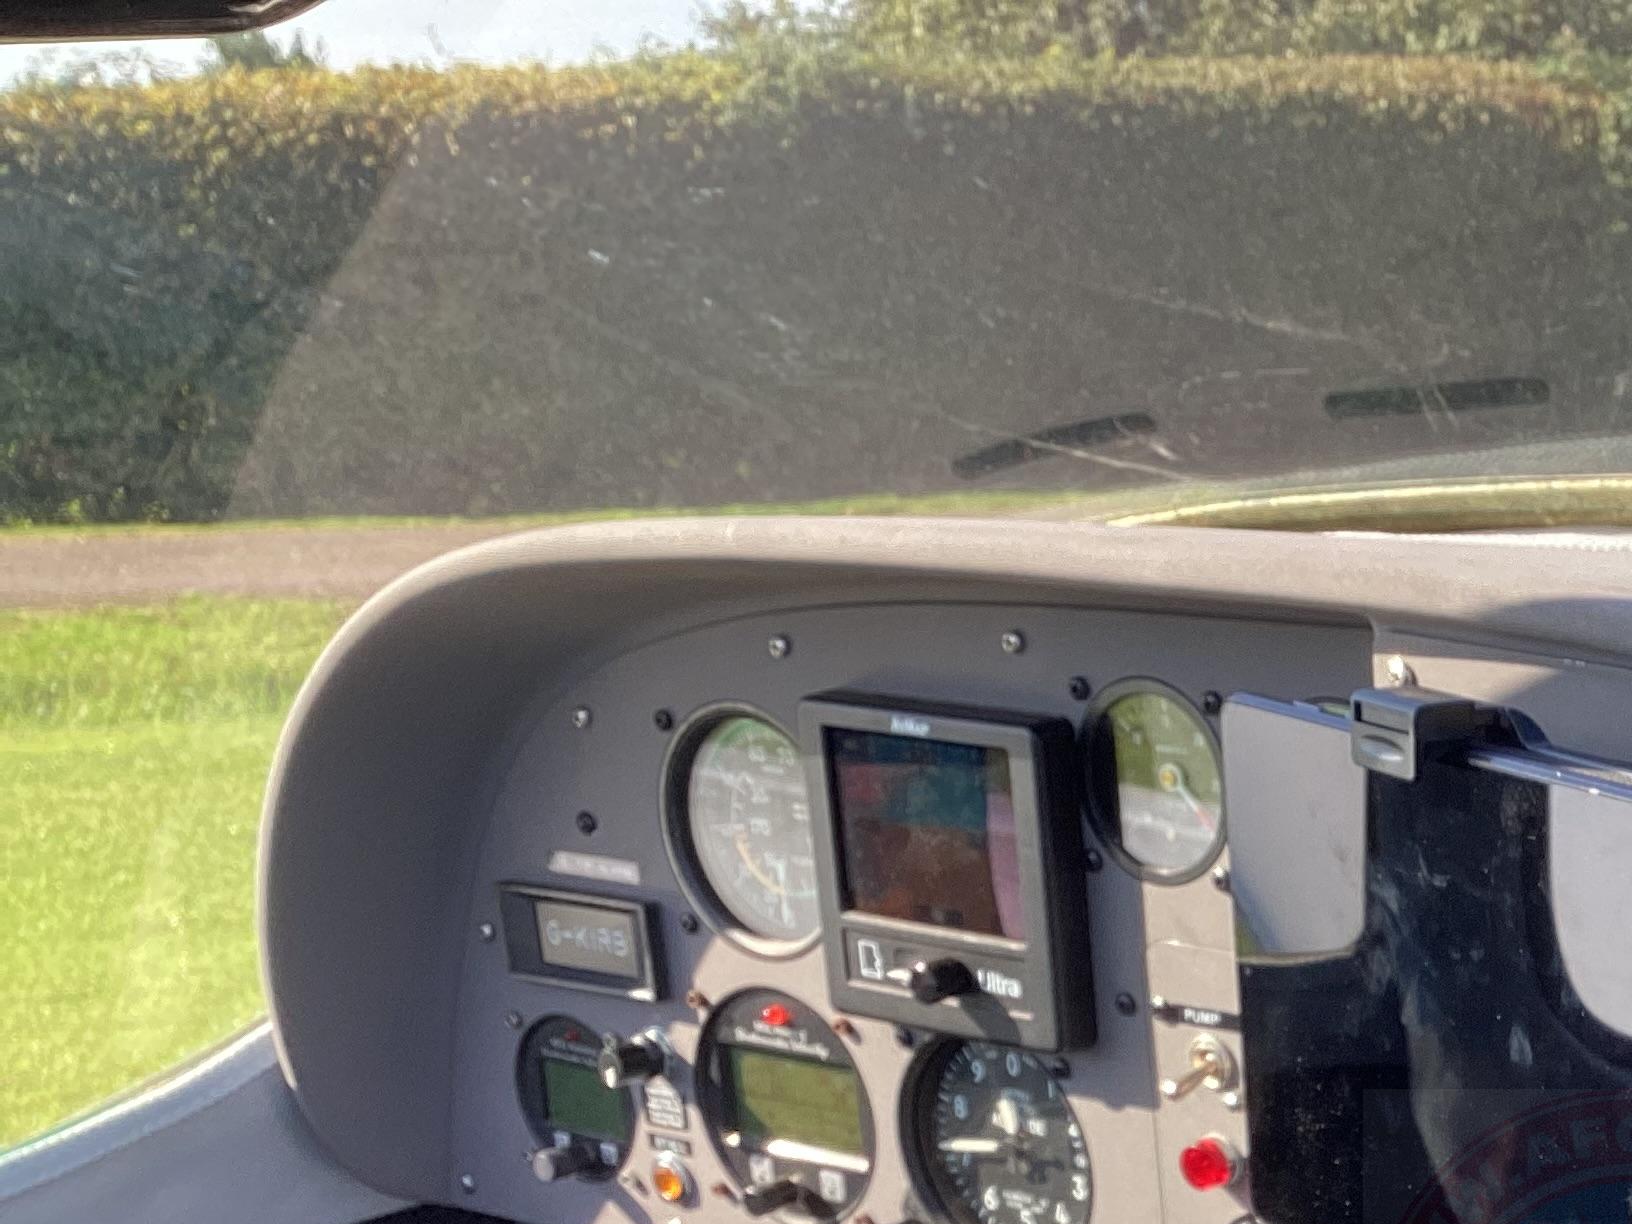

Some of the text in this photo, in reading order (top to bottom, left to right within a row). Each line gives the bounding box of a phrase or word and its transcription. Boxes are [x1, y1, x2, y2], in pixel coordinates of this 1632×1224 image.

[1184, 1008, 1219, 1025] PUMP
[984, 1185, 999, 1211] 6
[1072, 1175, 1088, 1200] 3
